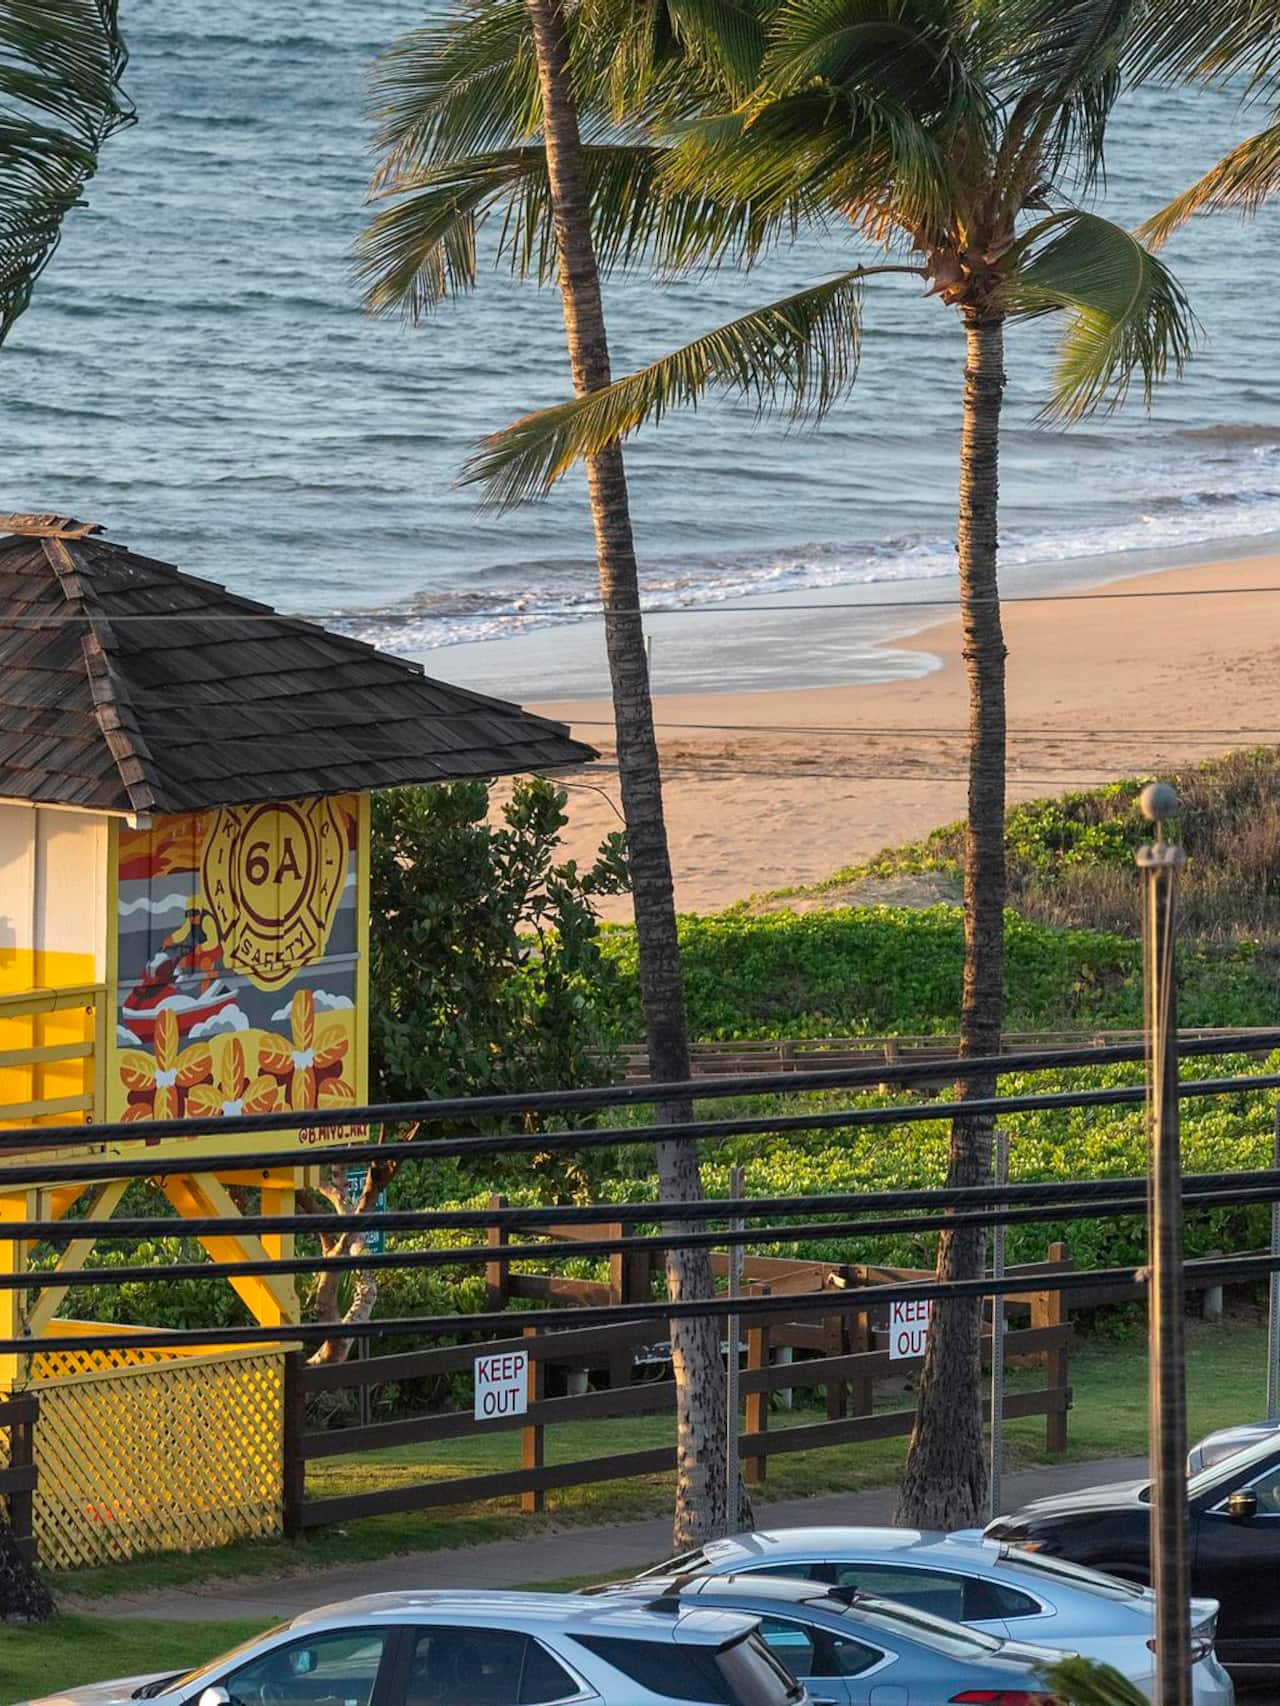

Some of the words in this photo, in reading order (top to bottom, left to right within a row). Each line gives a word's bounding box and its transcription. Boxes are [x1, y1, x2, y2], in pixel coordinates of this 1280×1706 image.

[245, 837, 302, 887] 6A
[240, 931, 305, 970] SAFETY
[478, 1355, 524, 1385] KEEP
[483, 1388, 520, 1415] OUT
